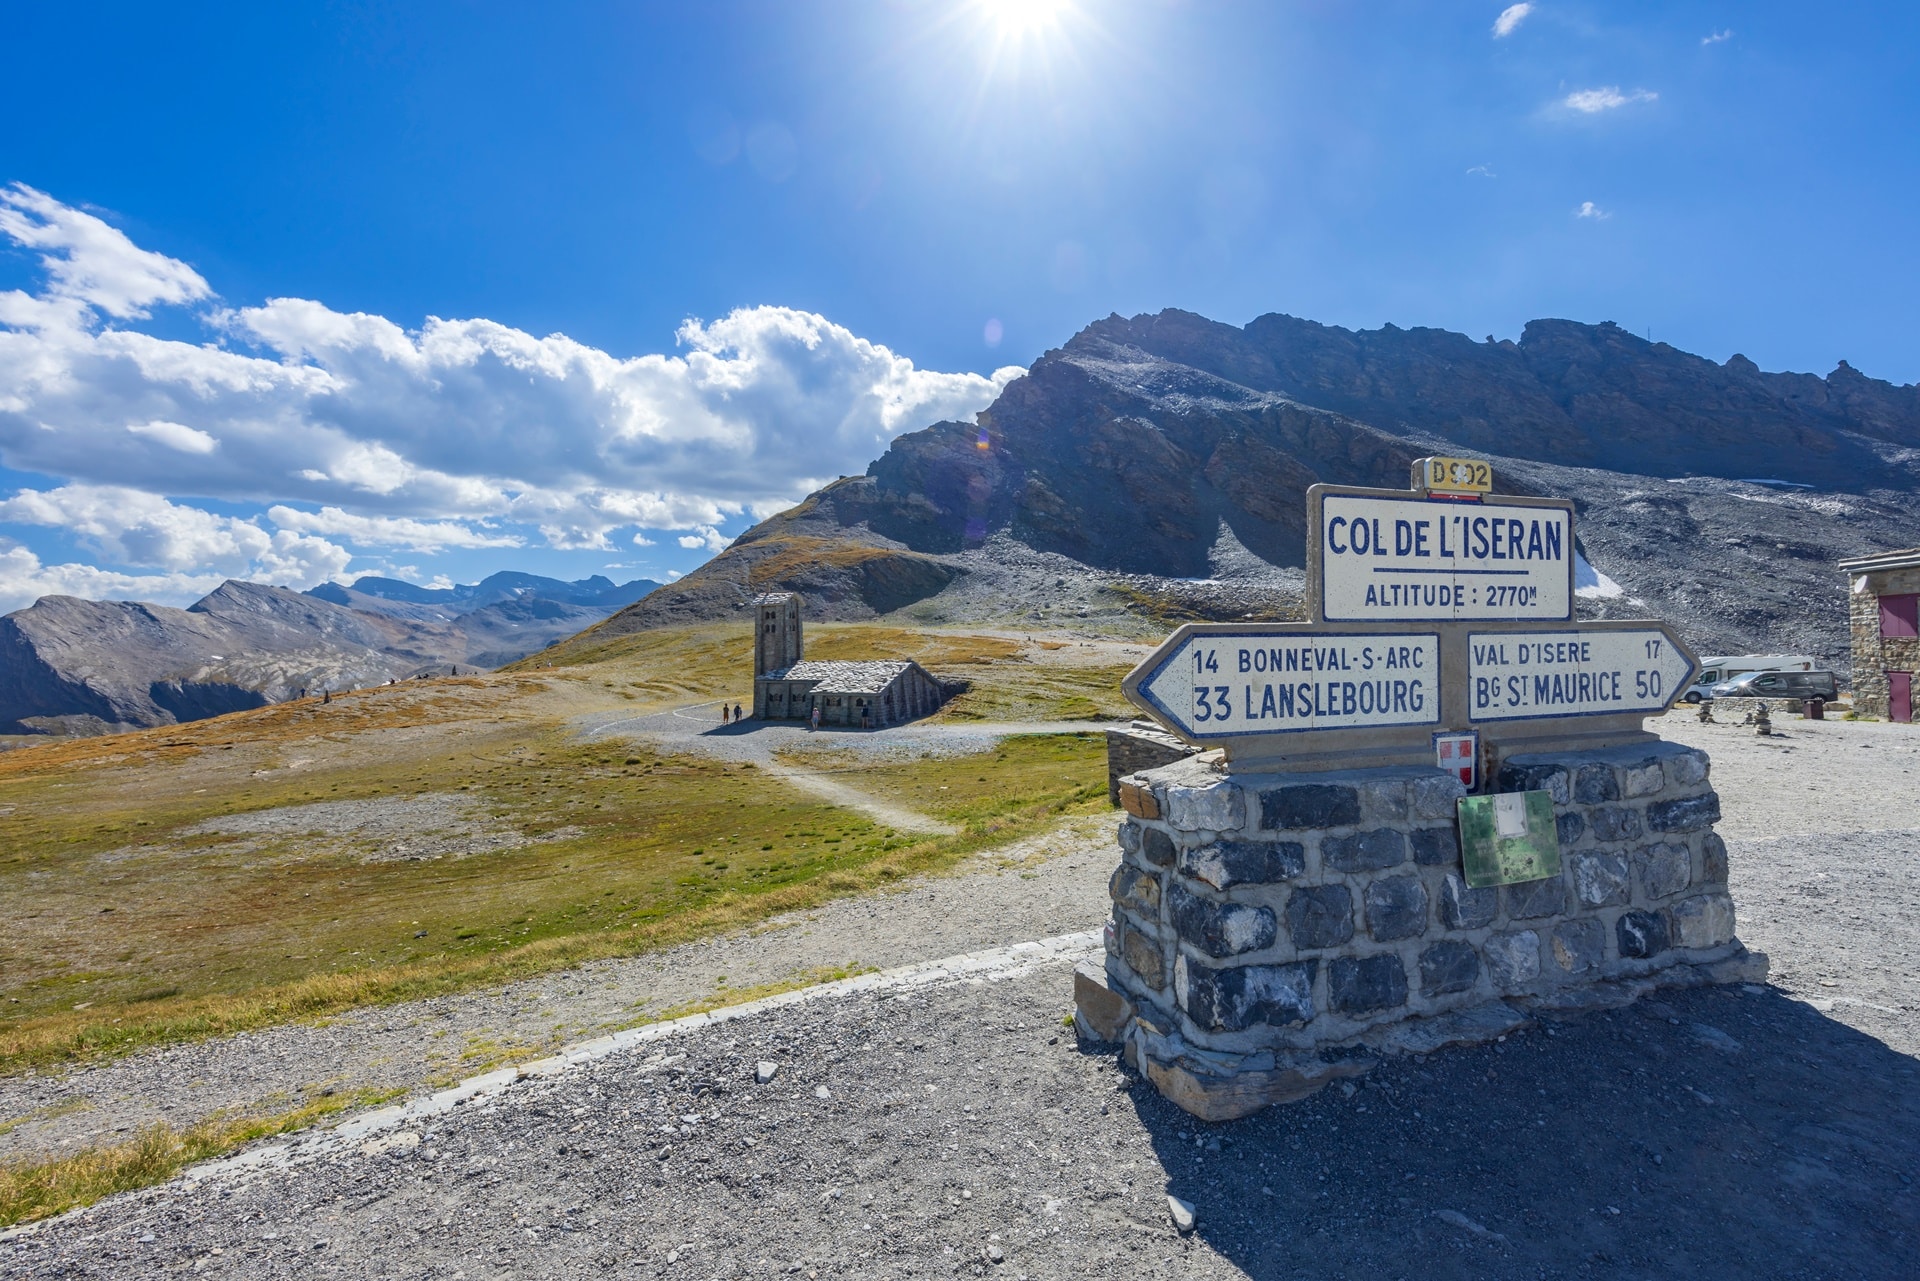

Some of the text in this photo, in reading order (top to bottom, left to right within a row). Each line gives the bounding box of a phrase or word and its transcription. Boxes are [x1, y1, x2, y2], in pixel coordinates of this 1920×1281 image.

[1433, 461, 1445, 483] D
[1328, 515, 1561, 560] COL DE L'ISERAN
[1365, 584, 1465, 607] ALTITUDE
[1193, 649, 1219, 674] 14
[1474, 642, 1590, 666] VAL D'ISERE
[1645, 640, 1660, 659] 17
[1534, 671, 1622, 705] MAURICE
[1636, 670, 1662, 699] 50
[1193, 679, 1424, 722] 33 LANSLEBOURG
